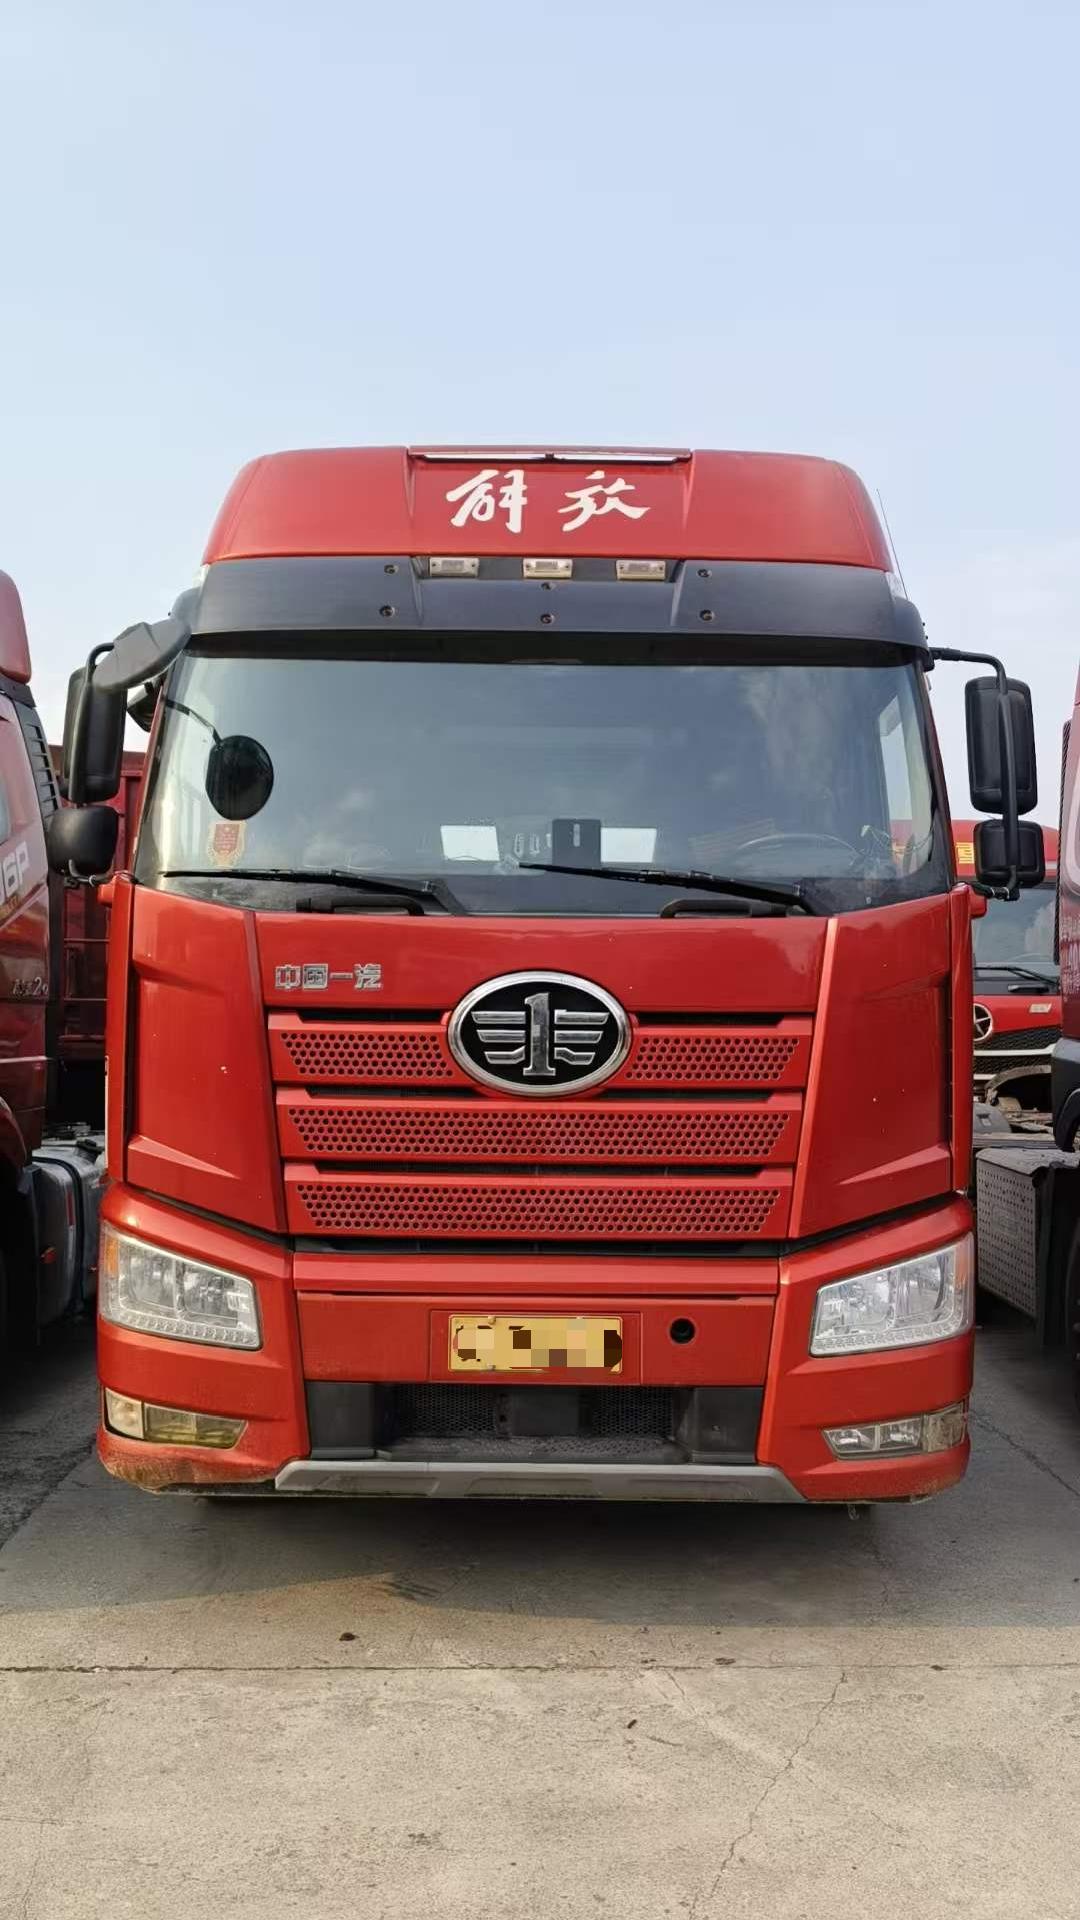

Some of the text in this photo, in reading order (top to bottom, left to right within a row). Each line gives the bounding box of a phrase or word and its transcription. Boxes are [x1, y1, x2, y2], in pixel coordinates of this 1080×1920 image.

[446, 469, 650, 533] 解放
[275, 963, 382, 991] 中国一汽
